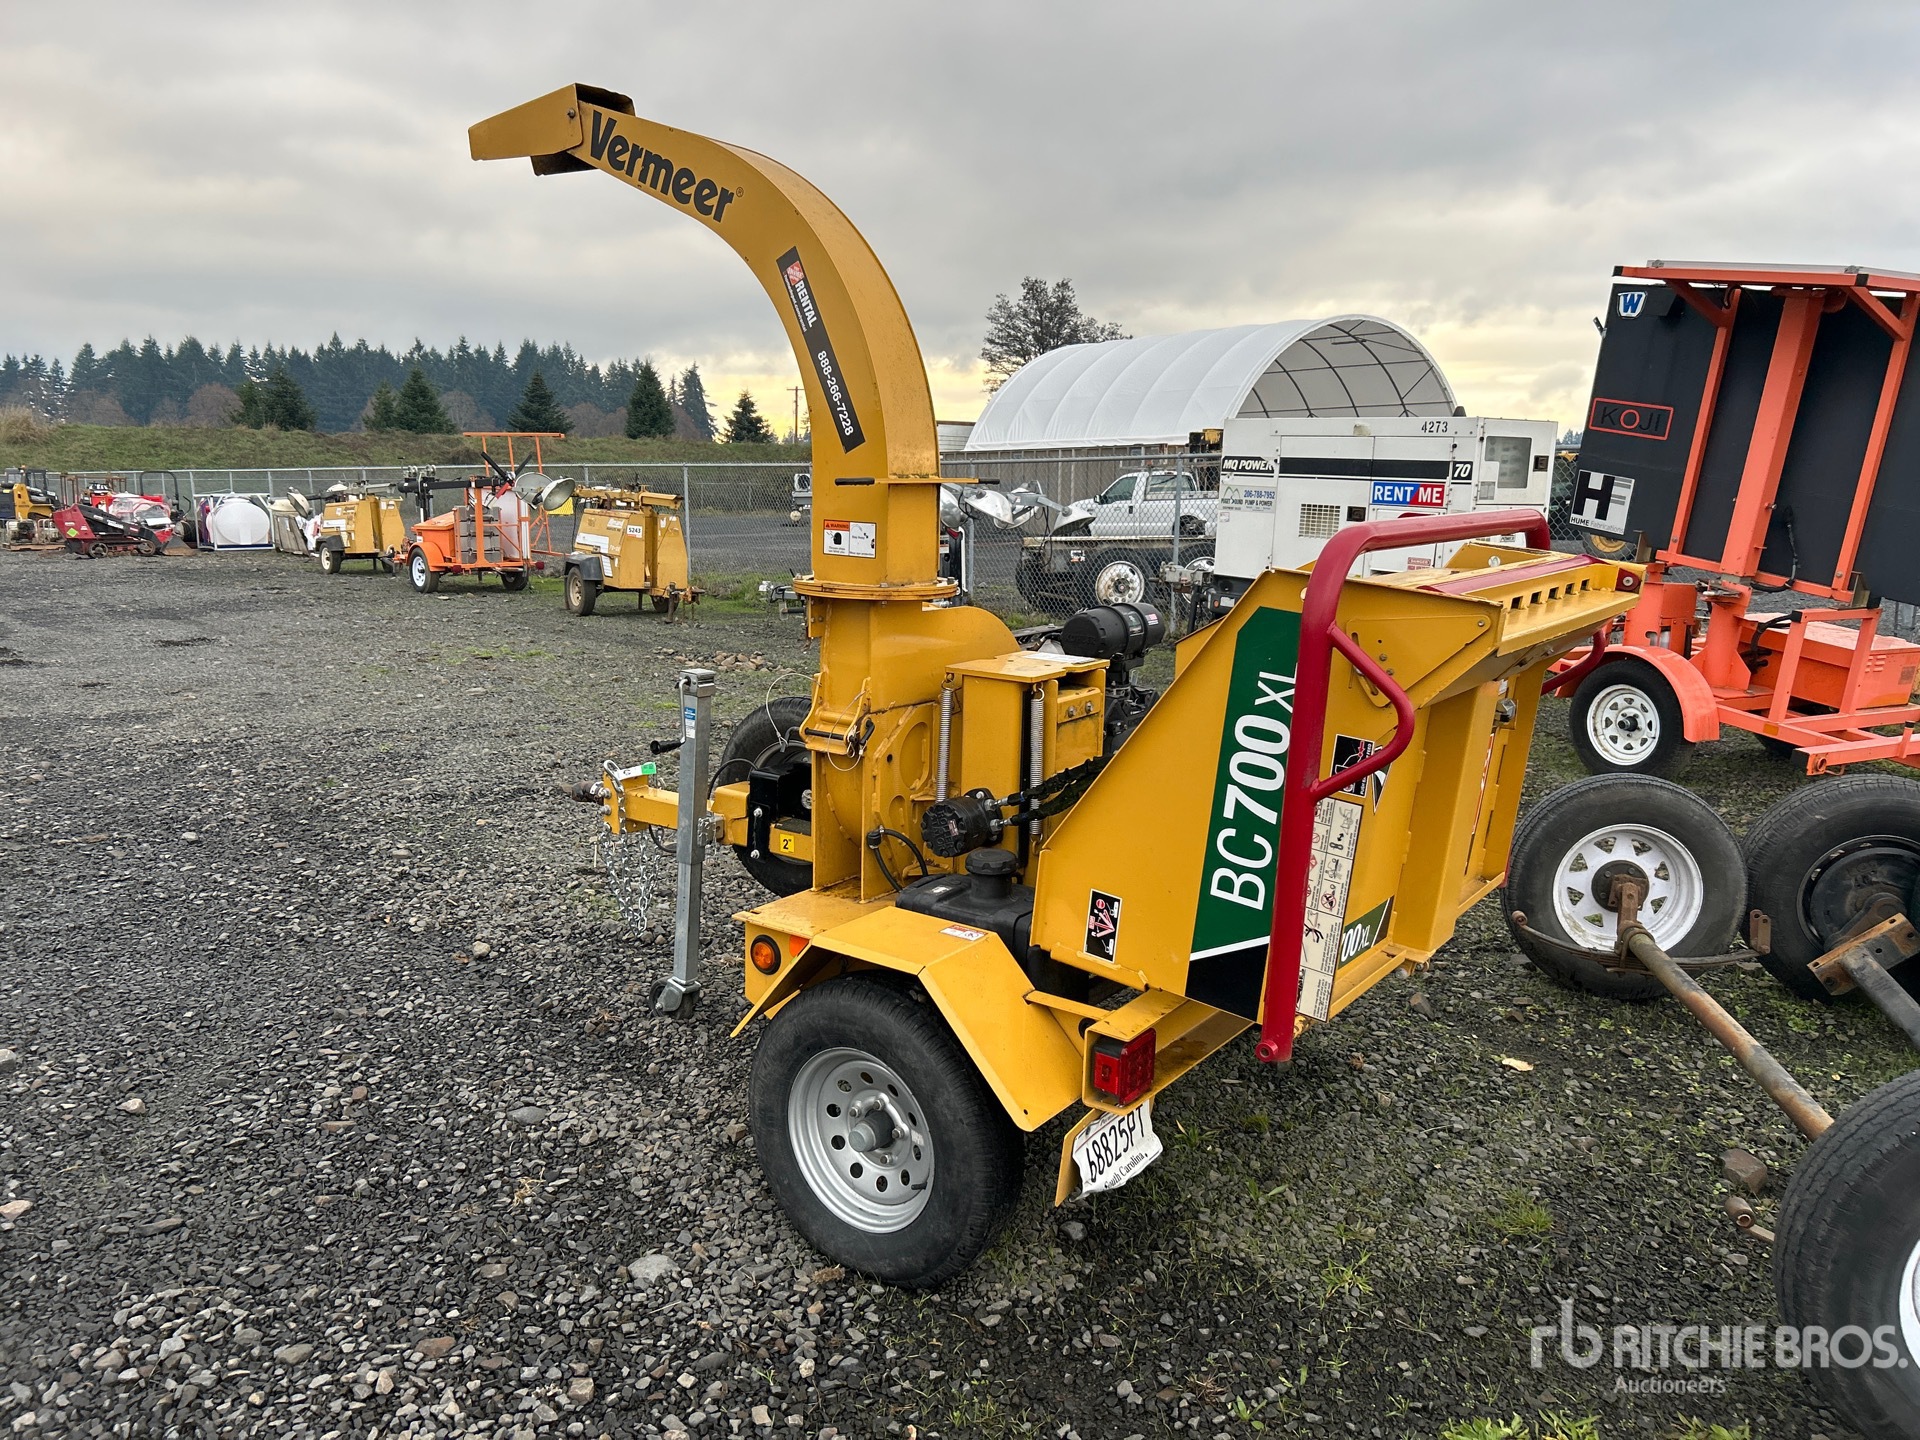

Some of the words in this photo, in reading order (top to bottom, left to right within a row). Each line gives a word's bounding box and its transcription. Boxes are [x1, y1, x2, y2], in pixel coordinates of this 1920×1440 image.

[590, 109, 735, 223] Vermeer
[795, 280, 817, 328] RENTAL
[817, 350, 854, 437] 888-266-7228
[1421, 421, 1448, 434] 4273
[1600, 405, 1662, 432] KOJI
[1223, 459, 1239, 470] MQ
[1453, 463, 1471, 478] 70
[1243, 489, 1276, 499] 206-788-7952
[1374, 485, 1415, 502] RENT
[1418, 487, 1443, 504] ME
[1570, 516, 1590, 526] HUME
[1590, 520, 1624, 533] Fabrications
[1104, 1172, 1121, 1189] South
[1119, 1152, 1146, 1177] Carolina
